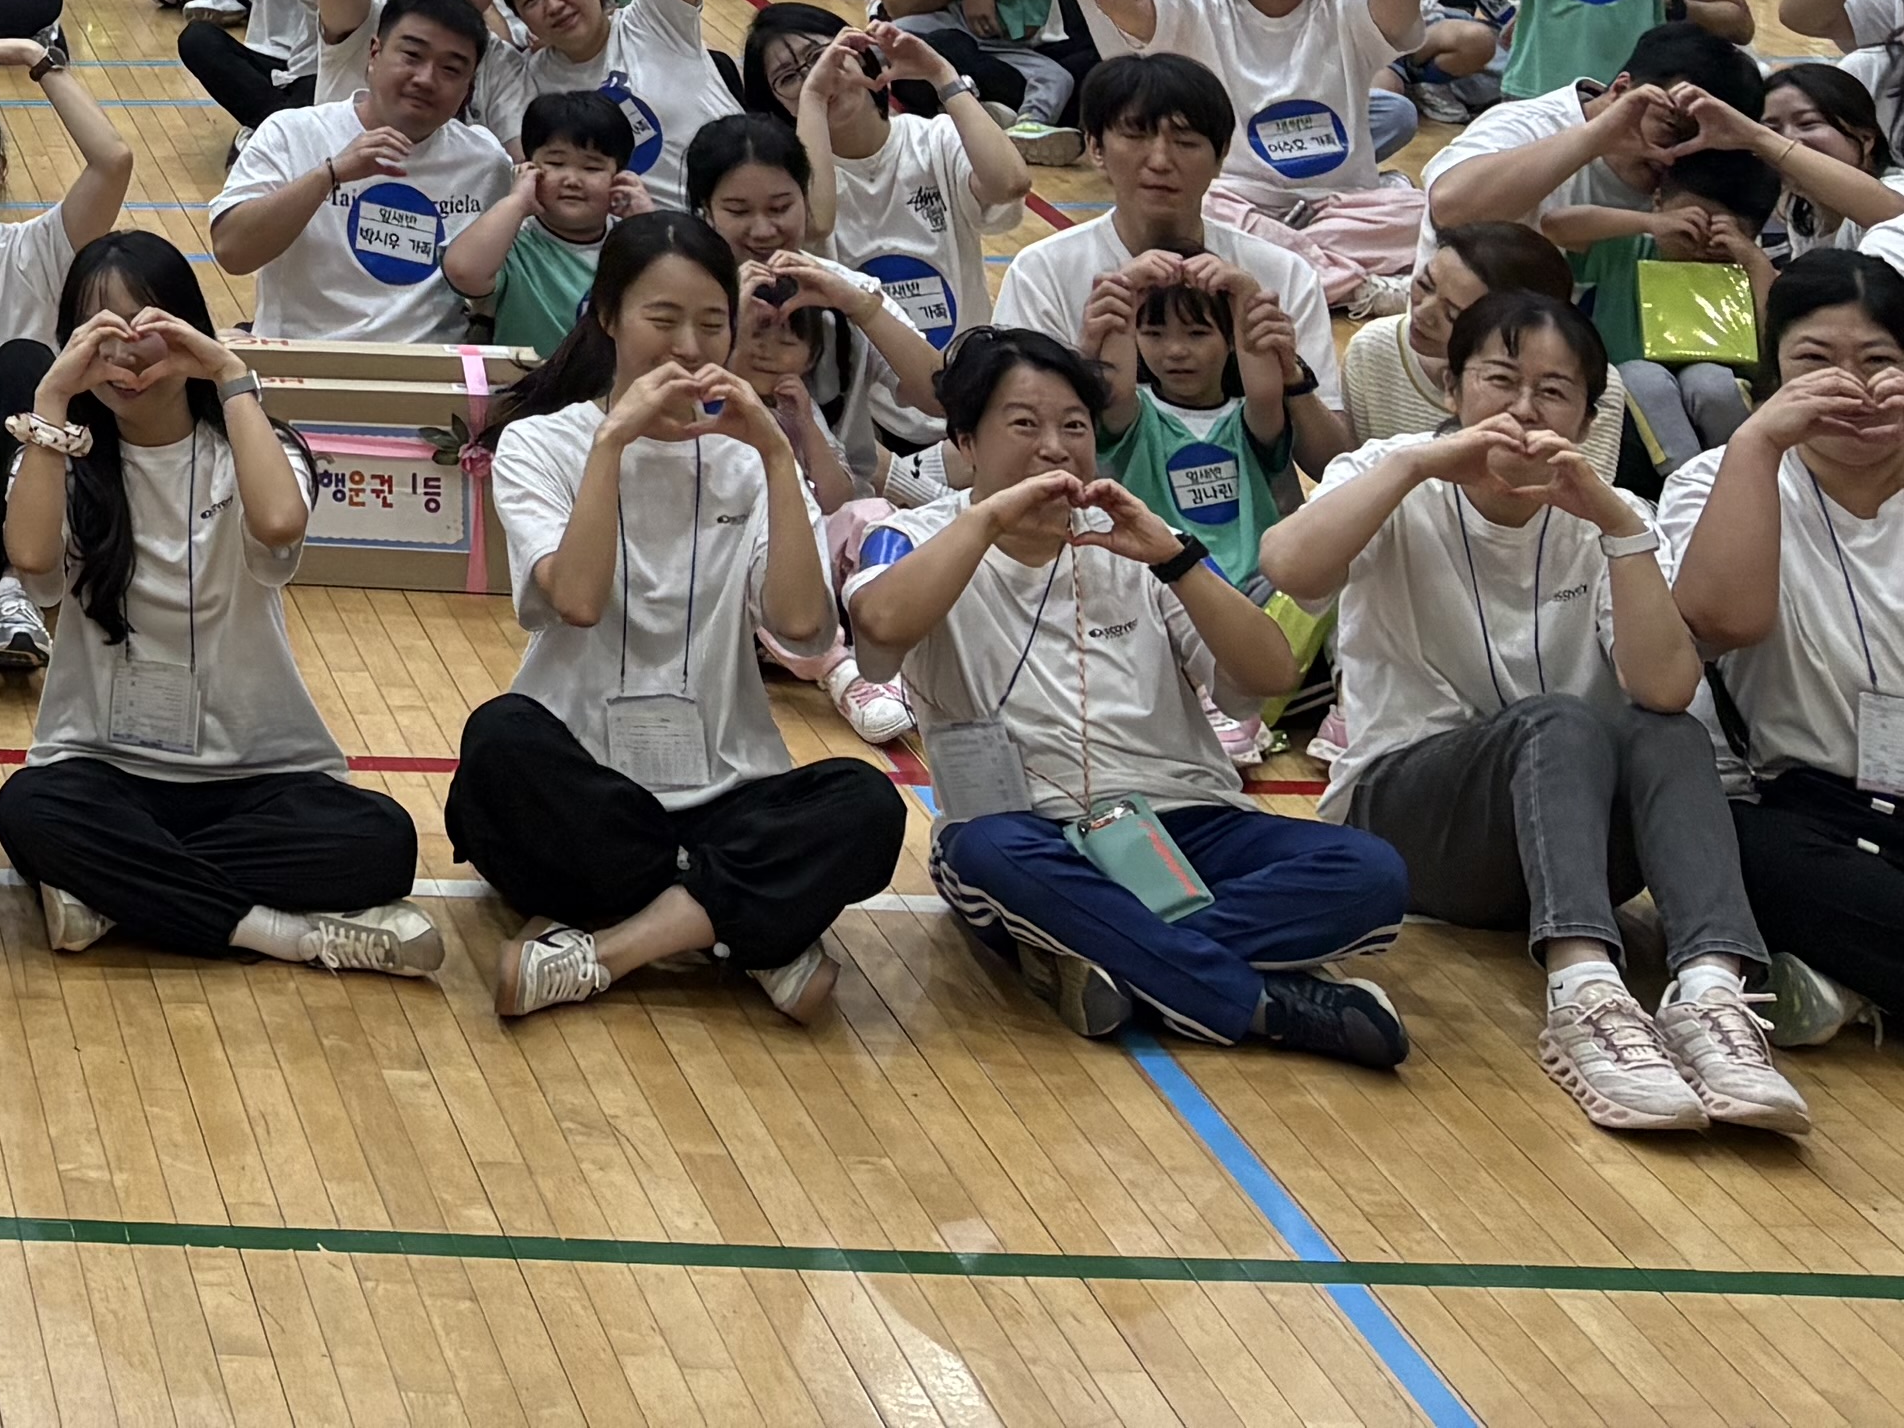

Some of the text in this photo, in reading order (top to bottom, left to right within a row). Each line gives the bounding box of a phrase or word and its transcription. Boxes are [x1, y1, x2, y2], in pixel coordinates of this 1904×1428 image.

[359, 227, 433, 257] 박시우 가족
[918, 302, 949, 320] 가족
[317, 468, 394, 509] 행운권
[1187, 483, 1234, 505] 김나린
